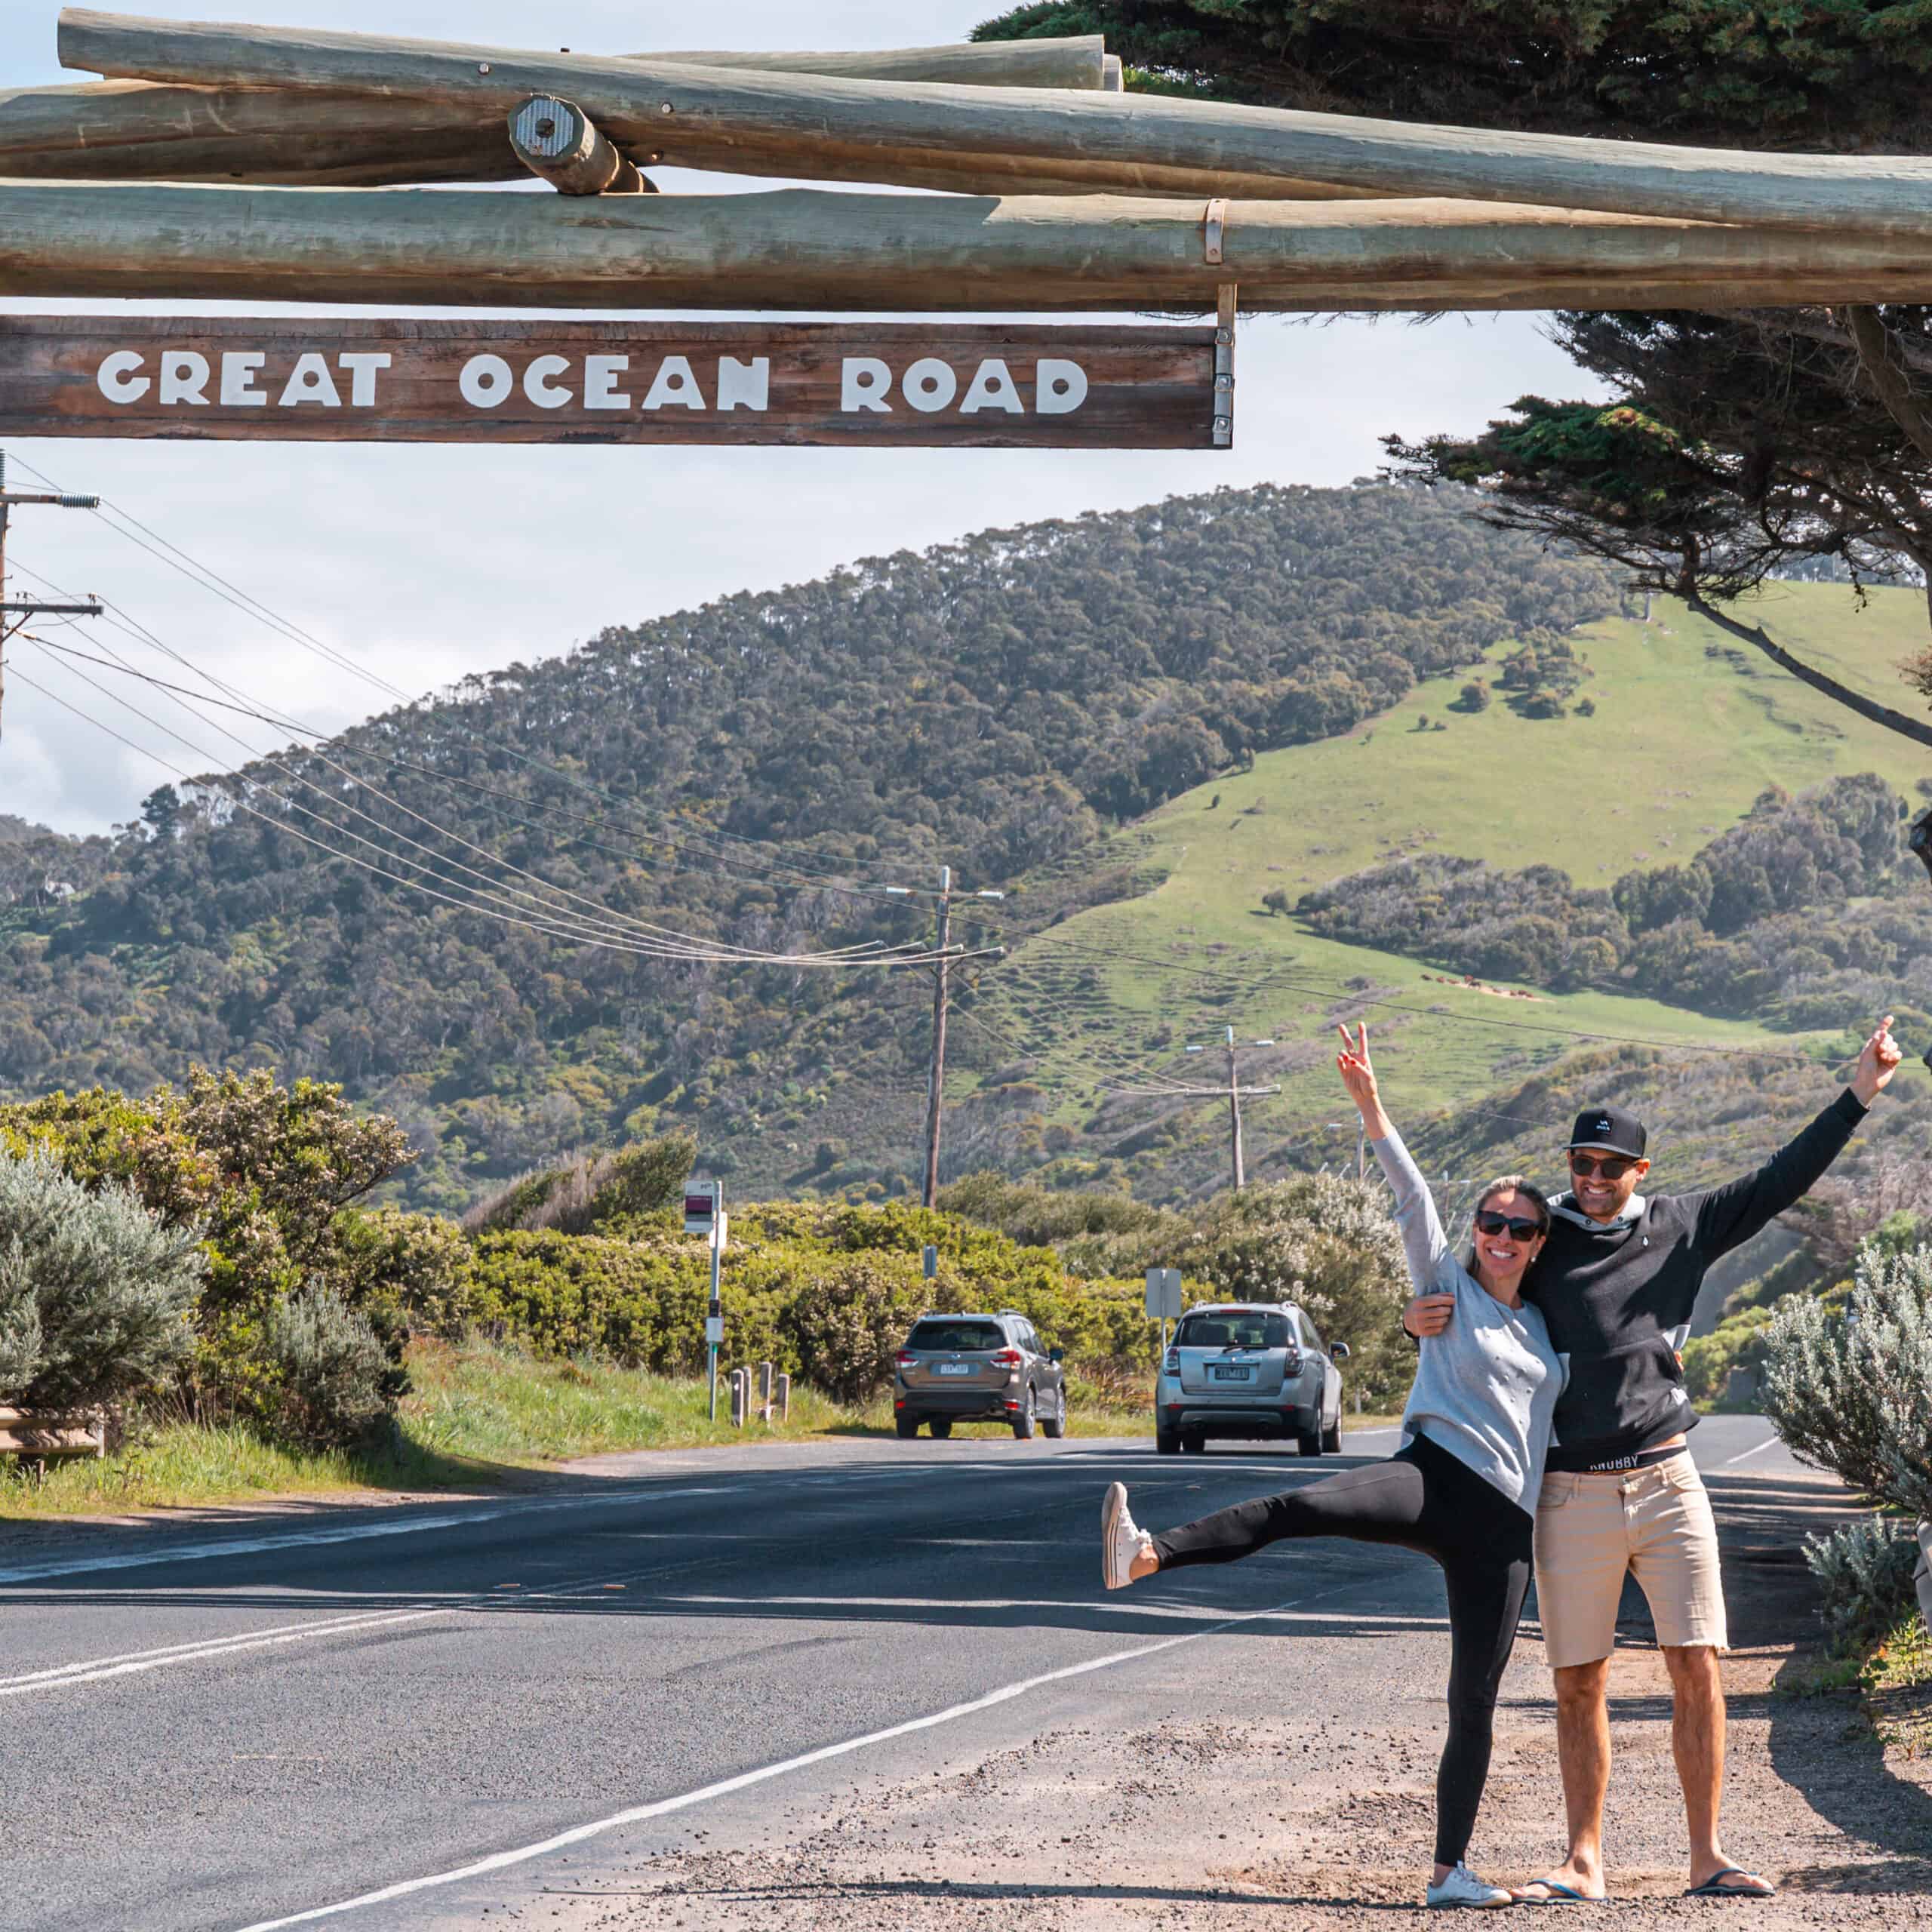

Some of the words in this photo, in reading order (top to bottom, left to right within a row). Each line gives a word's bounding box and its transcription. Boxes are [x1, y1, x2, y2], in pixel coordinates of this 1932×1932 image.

[96, 350, 392, 408] GREAT
[458, 353, 771, 411] OCEAN
[840, 358, 1088, 414] ROAD
